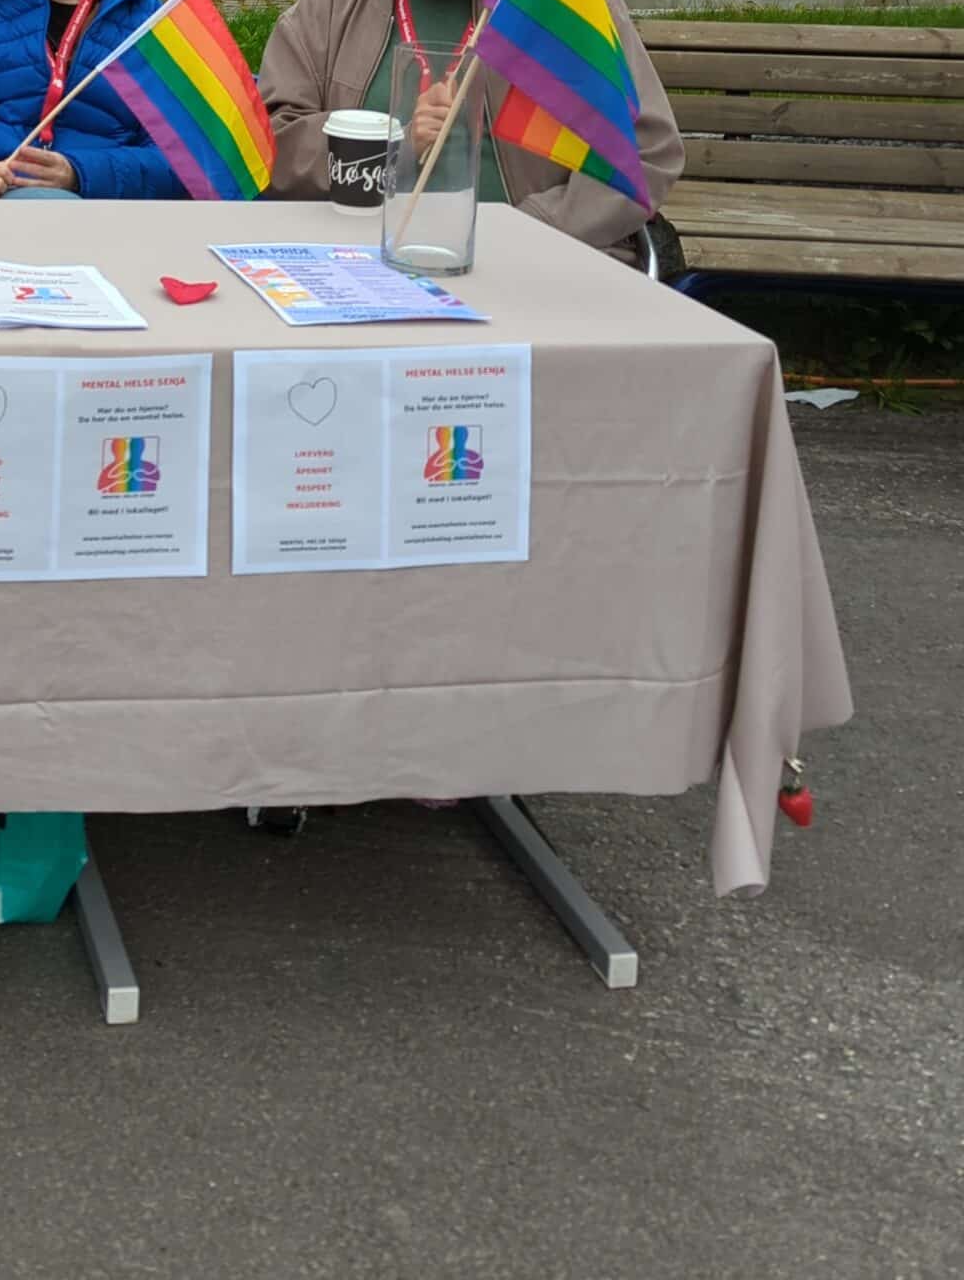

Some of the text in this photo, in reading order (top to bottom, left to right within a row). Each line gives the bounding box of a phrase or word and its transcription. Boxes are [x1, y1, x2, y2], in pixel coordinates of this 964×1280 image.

[405, 366, 506, 378] MENTAL HELSE SENJA
[82, 377, 186, 389] MENTAL HELSE SENJA
